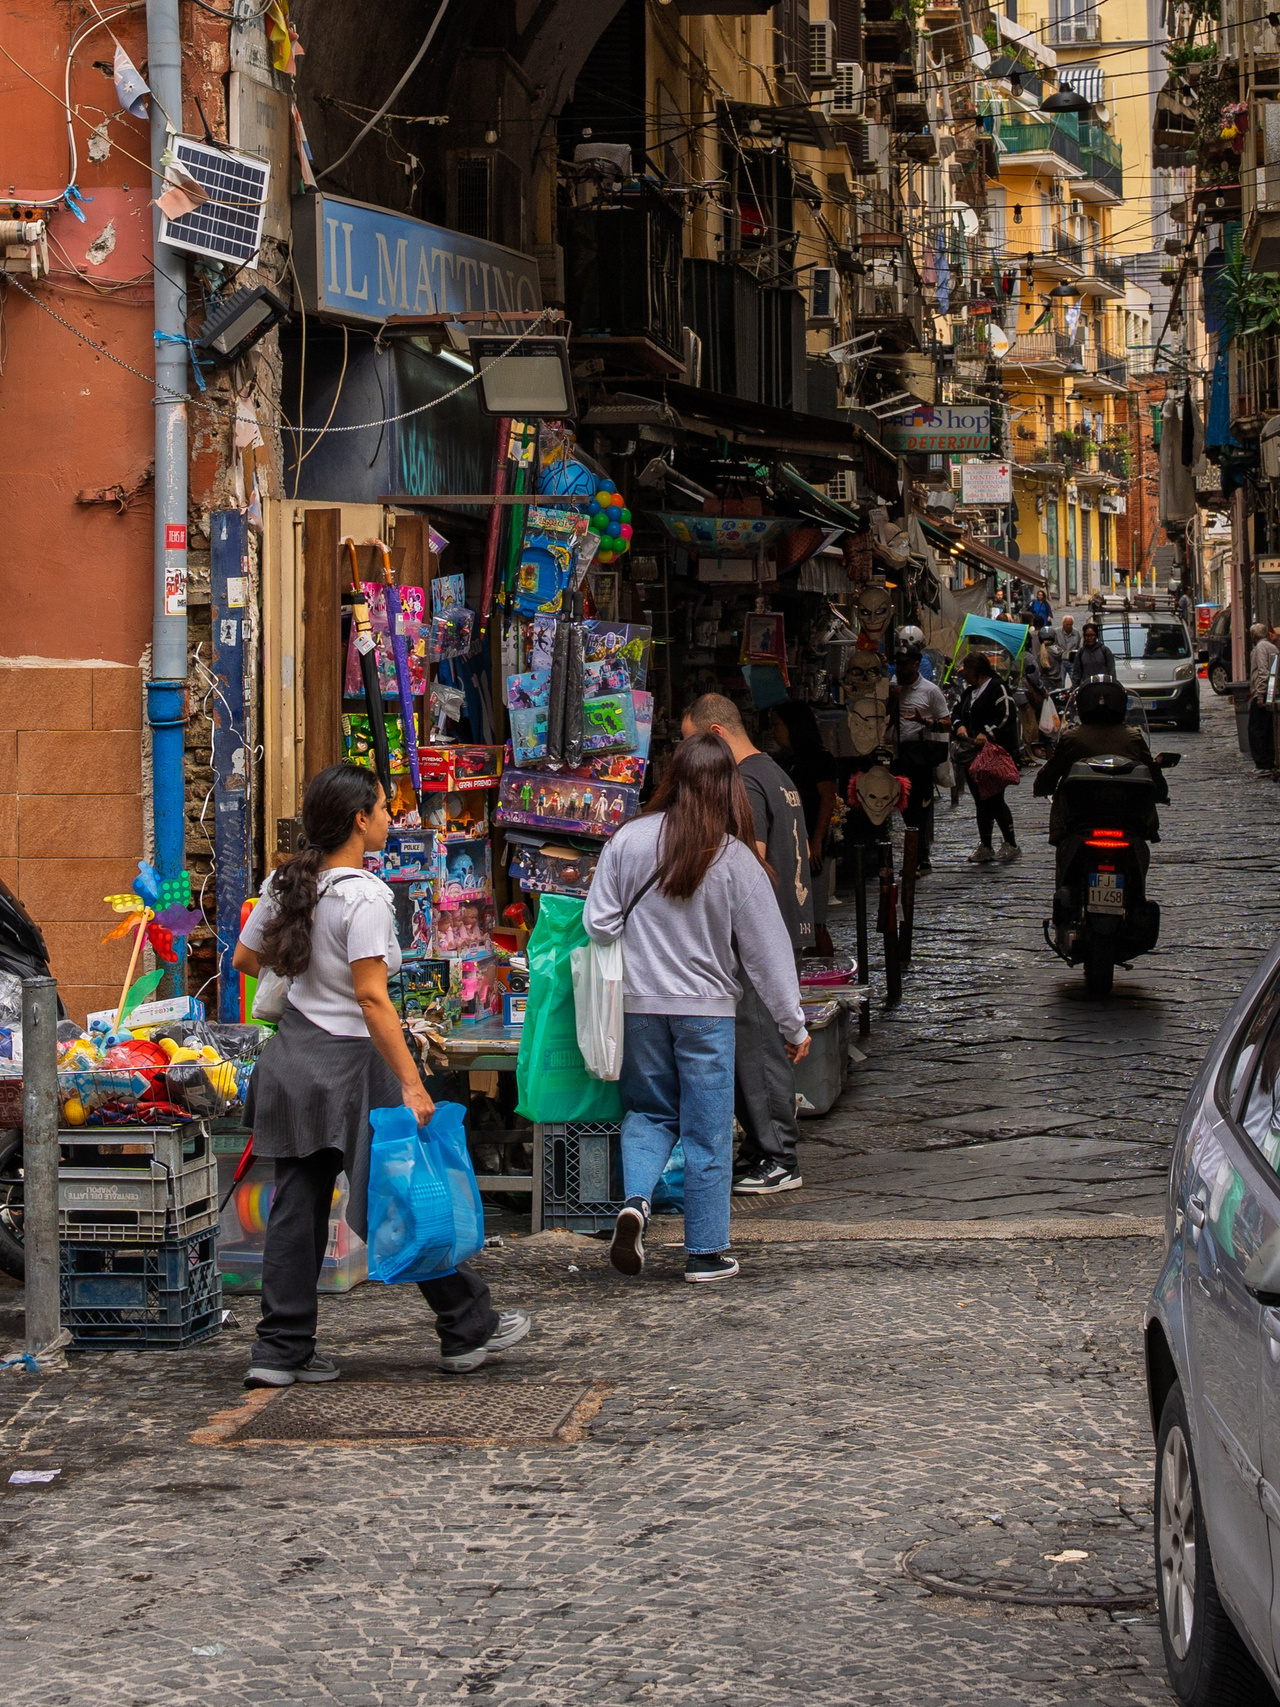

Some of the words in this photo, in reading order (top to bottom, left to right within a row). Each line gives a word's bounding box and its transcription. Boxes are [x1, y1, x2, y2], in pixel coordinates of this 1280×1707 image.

[326, 217, 368, 301] IL
[375, 232, 539, 336] MATTINO
[907, 435, 989, 450] DETERSIVI
[459, 781, 473, 789] GRAN
[473, 779, 492, 787] PREMIO
[1091, 890, 1122, 904] 11458
[68, 1192, 89, 1200] LATTE
